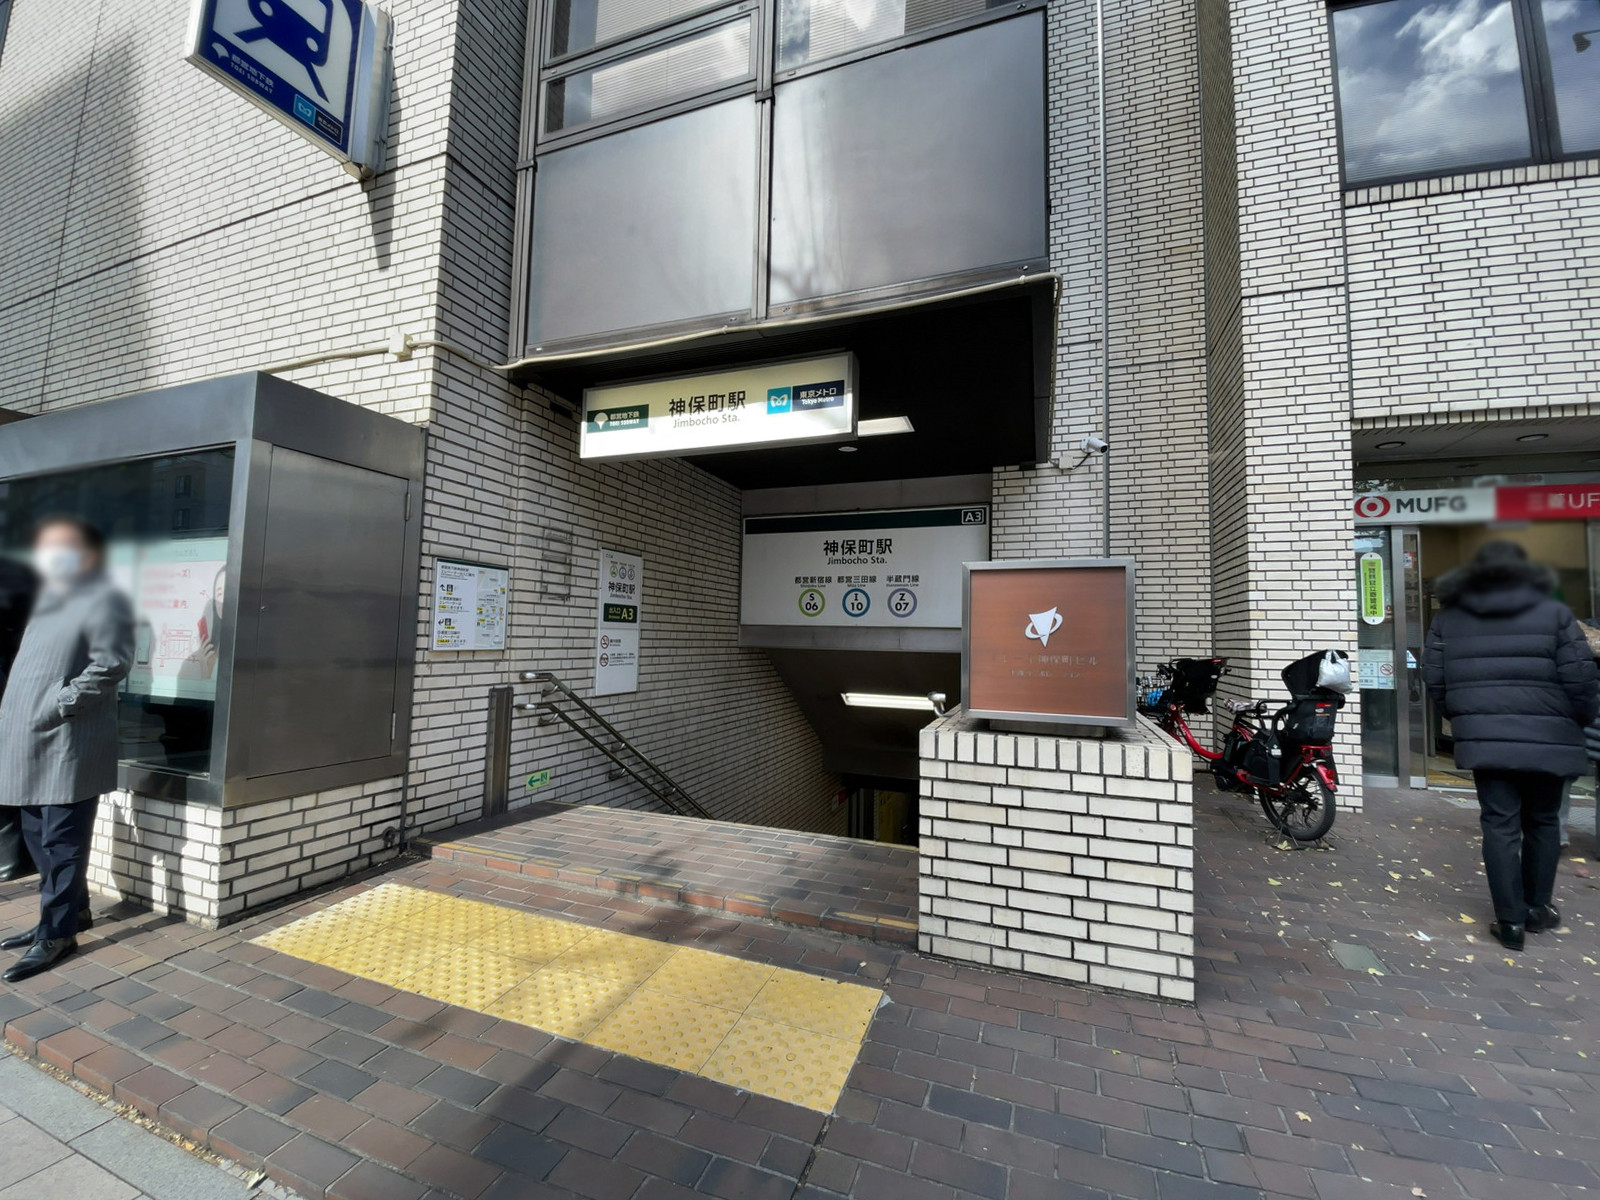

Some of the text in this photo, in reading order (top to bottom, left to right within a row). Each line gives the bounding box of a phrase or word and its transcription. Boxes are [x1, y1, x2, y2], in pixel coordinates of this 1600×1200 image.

[800, 387, 837, 399] 東京メトロ
[668, 390, 746, 417] 神保町駅
[673, 414, 741, 429] Jimbocho Sta.
[1396, 496, 1467, 513] MUFG
[965, 511, 982, 522] A3
[823, 538, 893, 556] 神保町駅
[827, 555, 888, 565] Jimbocho Sta.
[795, 575, 833, 584] 都営新宿線
[837, 575, 877, 584] 都営三田線
[886, 574, 920, 583] 半蔵門線
[608, 581, 636, 595] 神保町駅
[809, 593, 815, 601] S
[854, 593, 859, 601] I
[899, 593, 906, 601] Z
[805, 602, 819, 611] 06
[851, 602, 864, 611] 10
[895, 602, 909, 611] 07
[621, 608, 634, 620] A3
